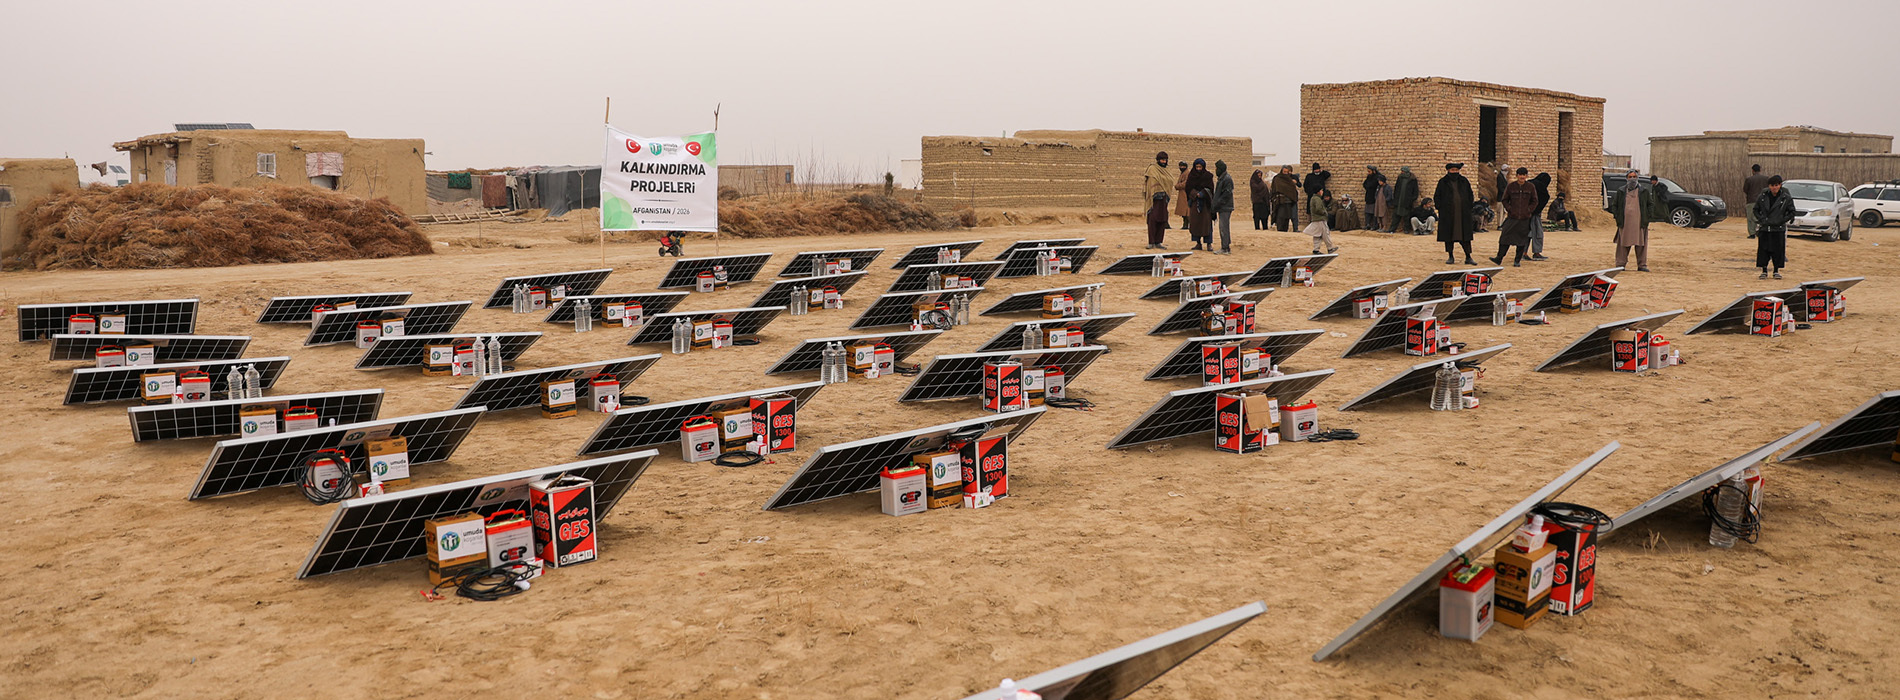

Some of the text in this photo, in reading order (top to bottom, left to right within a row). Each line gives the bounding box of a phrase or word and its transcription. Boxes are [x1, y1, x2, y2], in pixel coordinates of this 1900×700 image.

[620, 161, 706, 176] KALKINDIRMA
[1616, 343, 1634, 353] GES
[186, 392, 206, 400] GEP
[1002, 385, 1020, 398] GES
[773, 414, 794, 428] GES
[1219, 411, 1239, 427] GES
[1298, 420, 1314, 431] GEP
[775, 428, 792, 437] 1300
[1221, 426, 1237, 436] 1300
[695, 441, 715, 452] GEP
[982, 453, 1005, 472] GES
[985, 470, 1003, 482] 1300
[900, 491, 922, 504] GEP
[534, 508, 550, 531] GES
[463, 527, 483, 537] umuda
[559, 519, 590, 541] GES
[499, 545, 528, 562] GEP
[1578, 544, 1596, 572] GES
